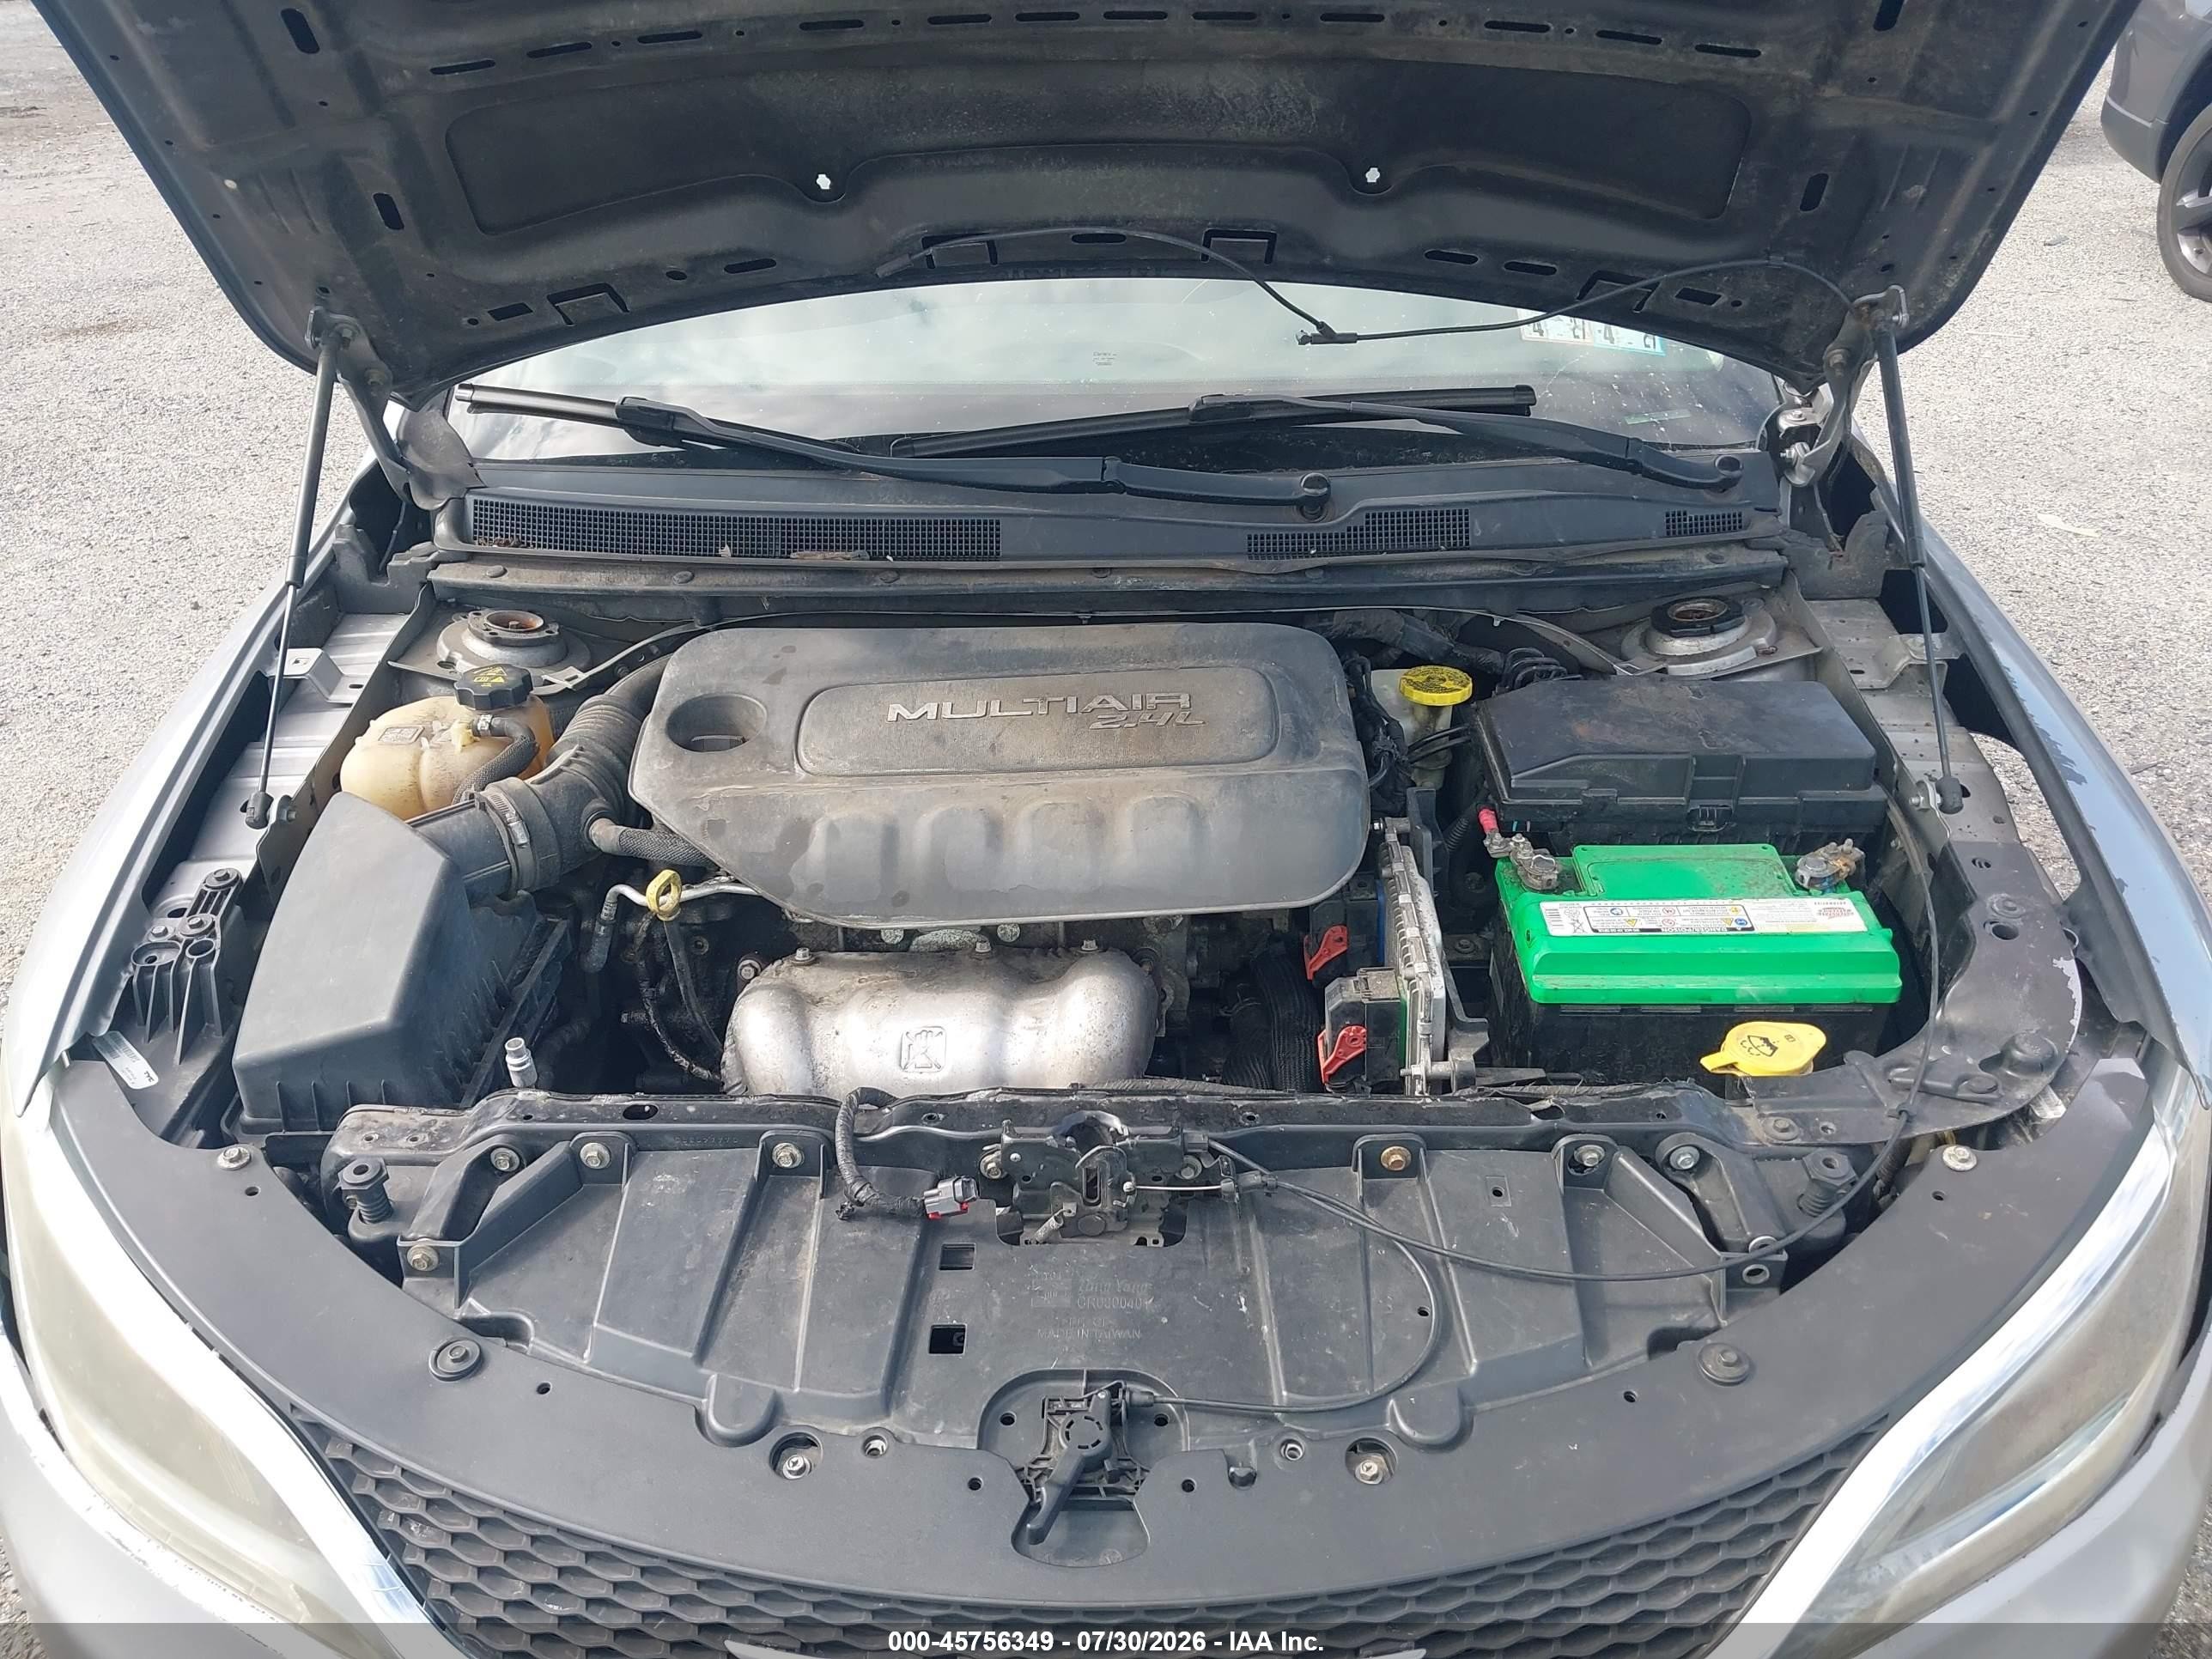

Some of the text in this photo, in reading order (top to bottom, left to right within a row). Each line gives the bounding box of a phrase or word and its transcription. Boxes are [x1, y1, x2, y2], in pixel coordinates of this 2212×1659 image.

[886, 692, 1193, 723] MULTIAIR
[1089, 711, 1206, 730] 2.4L
[1077, 1328, 1090, 1340] IN
[1095, 1328, 1142, 1340] TAIWAN
